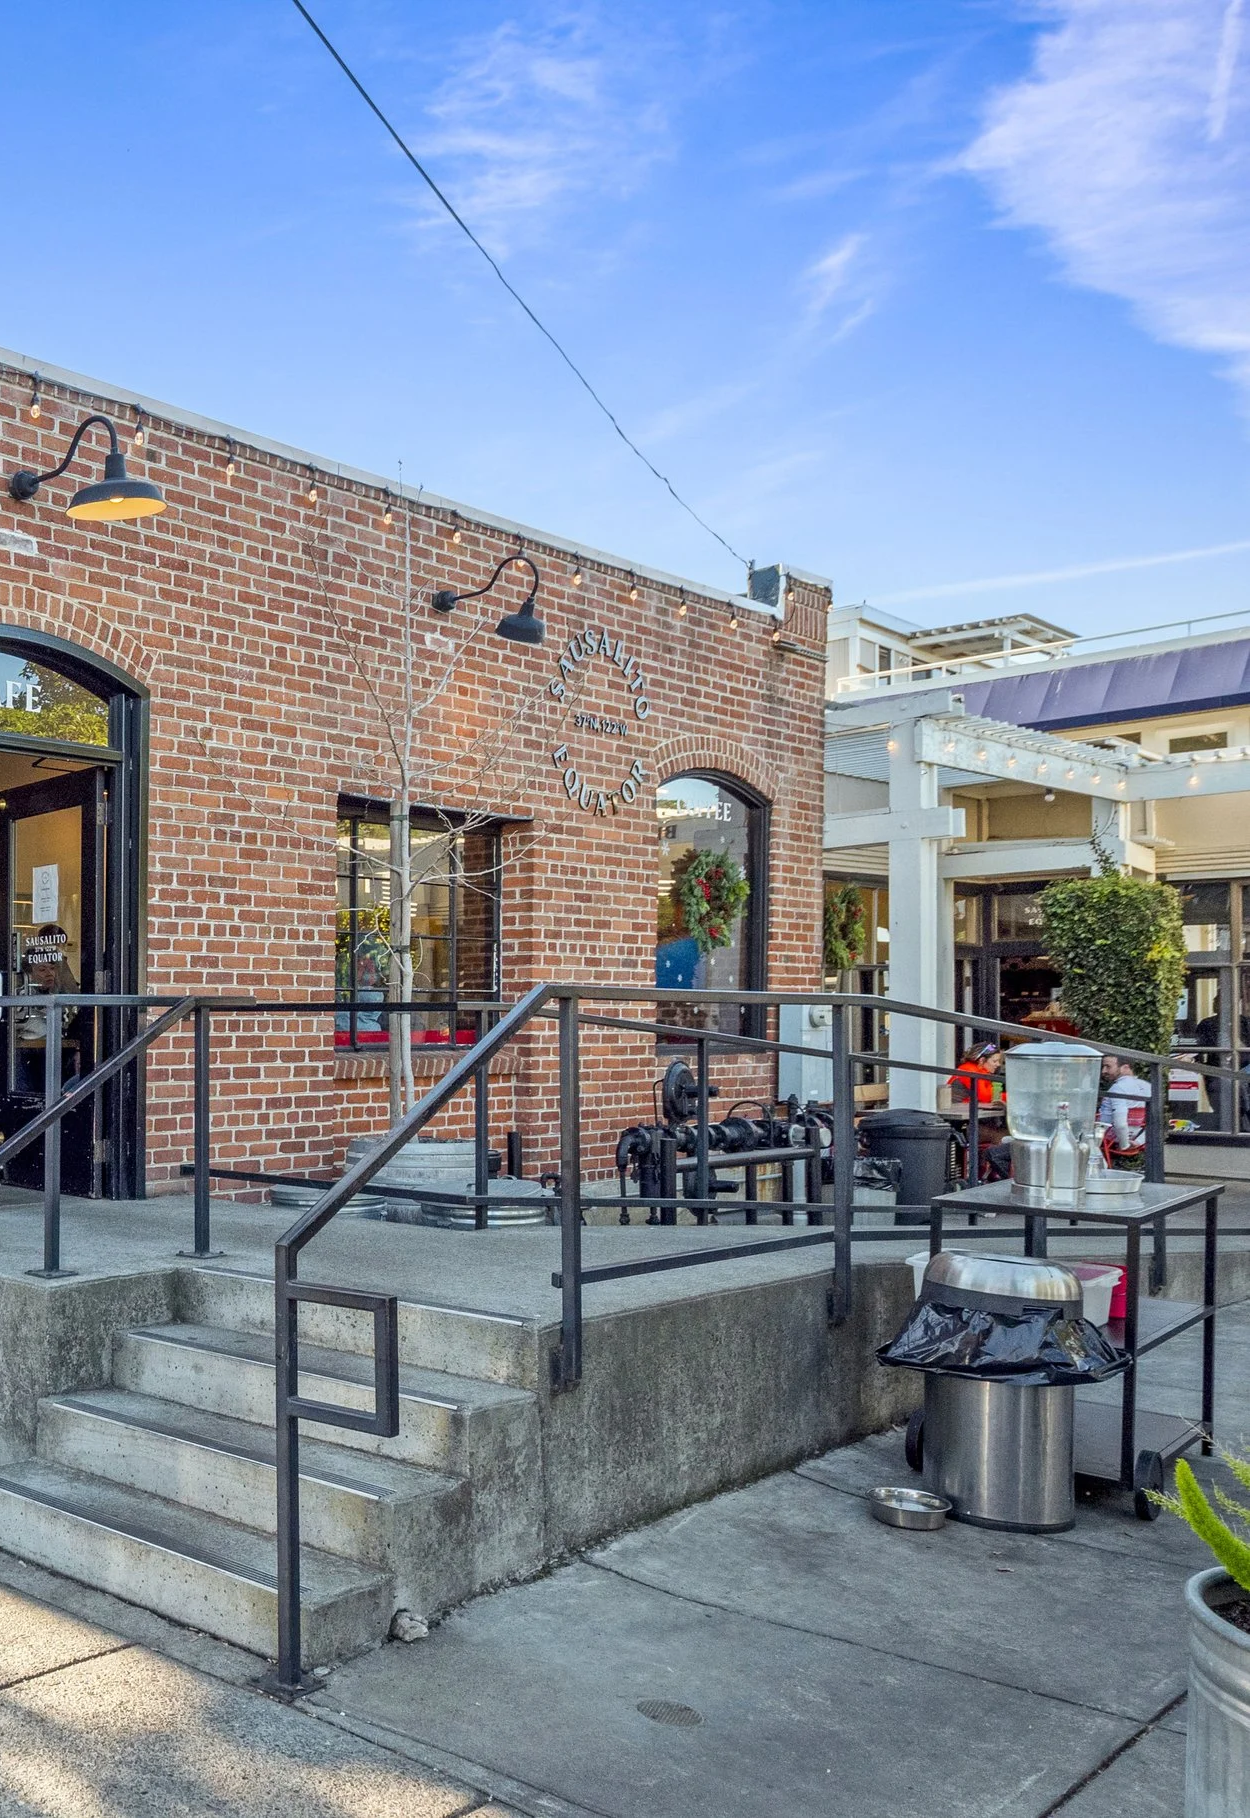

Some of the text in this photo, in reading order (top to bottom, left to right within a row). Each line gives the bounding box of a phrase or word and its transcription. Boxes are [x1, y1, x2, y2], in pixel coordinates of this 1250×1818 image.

[549, 629, 651, 721] SAUSALITO
[552, 743, 648, 817] EQUATOR
[25, 933, 66, 947] SAUSALITO
[28, 952, 63, 964] EQUATOR
